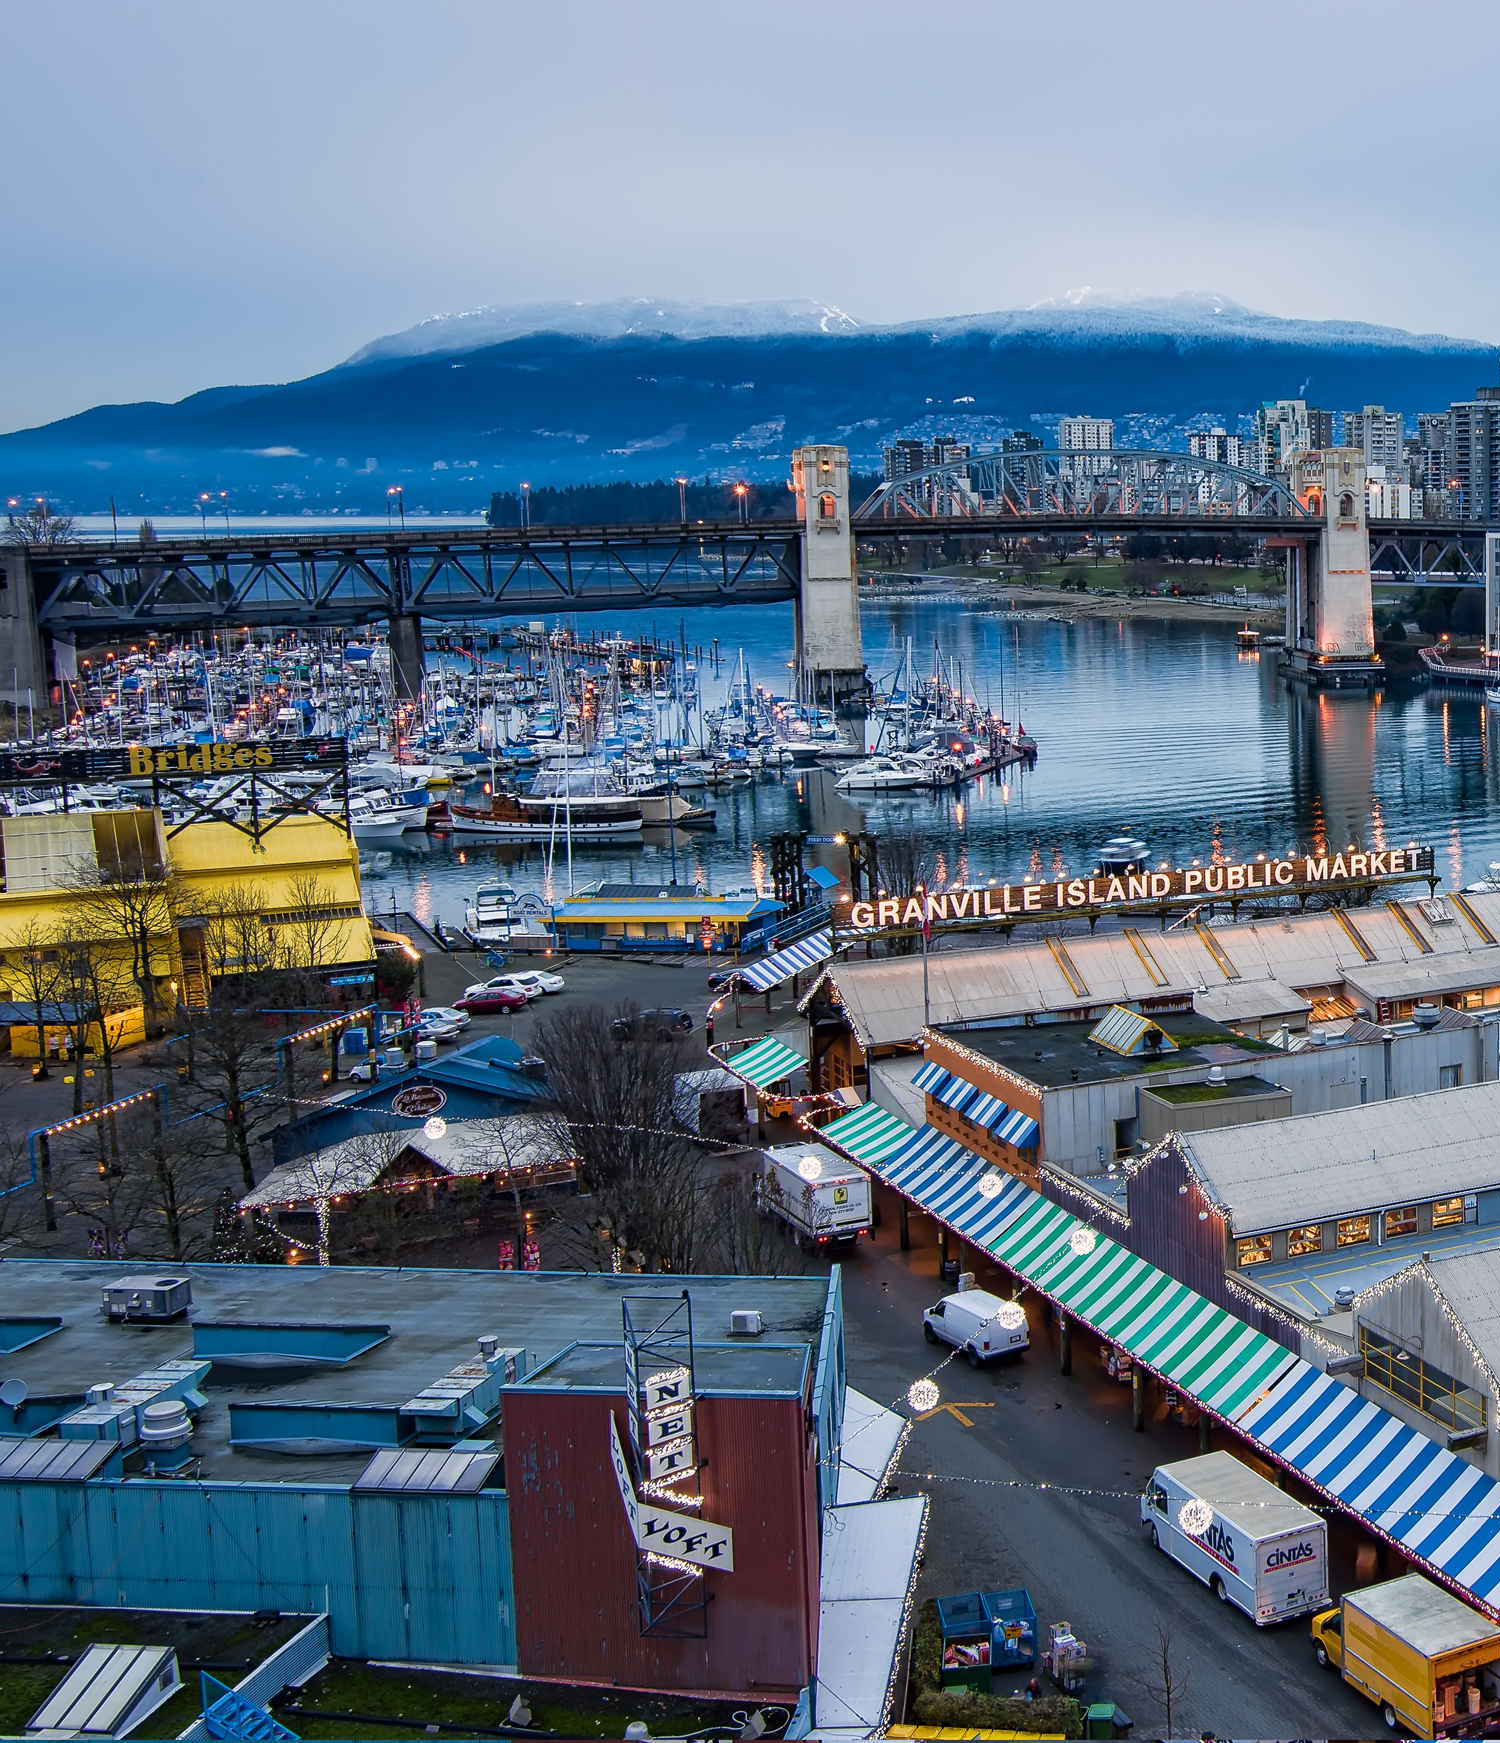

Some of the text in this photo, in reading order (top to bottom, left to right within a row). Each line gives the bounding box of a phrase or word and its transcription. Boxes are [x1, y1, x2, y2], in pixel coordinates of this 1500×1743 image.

[128, 742, 274, 776] Bridges
[851, 849, 1422, 928] GRANVILLE ISLAND PUBLIC MARKET
[653, 1380, 684, 1472] NET
[611, 1433, 636, 1522] LOFT
[642, 1517, 728, 1560] LOFT
